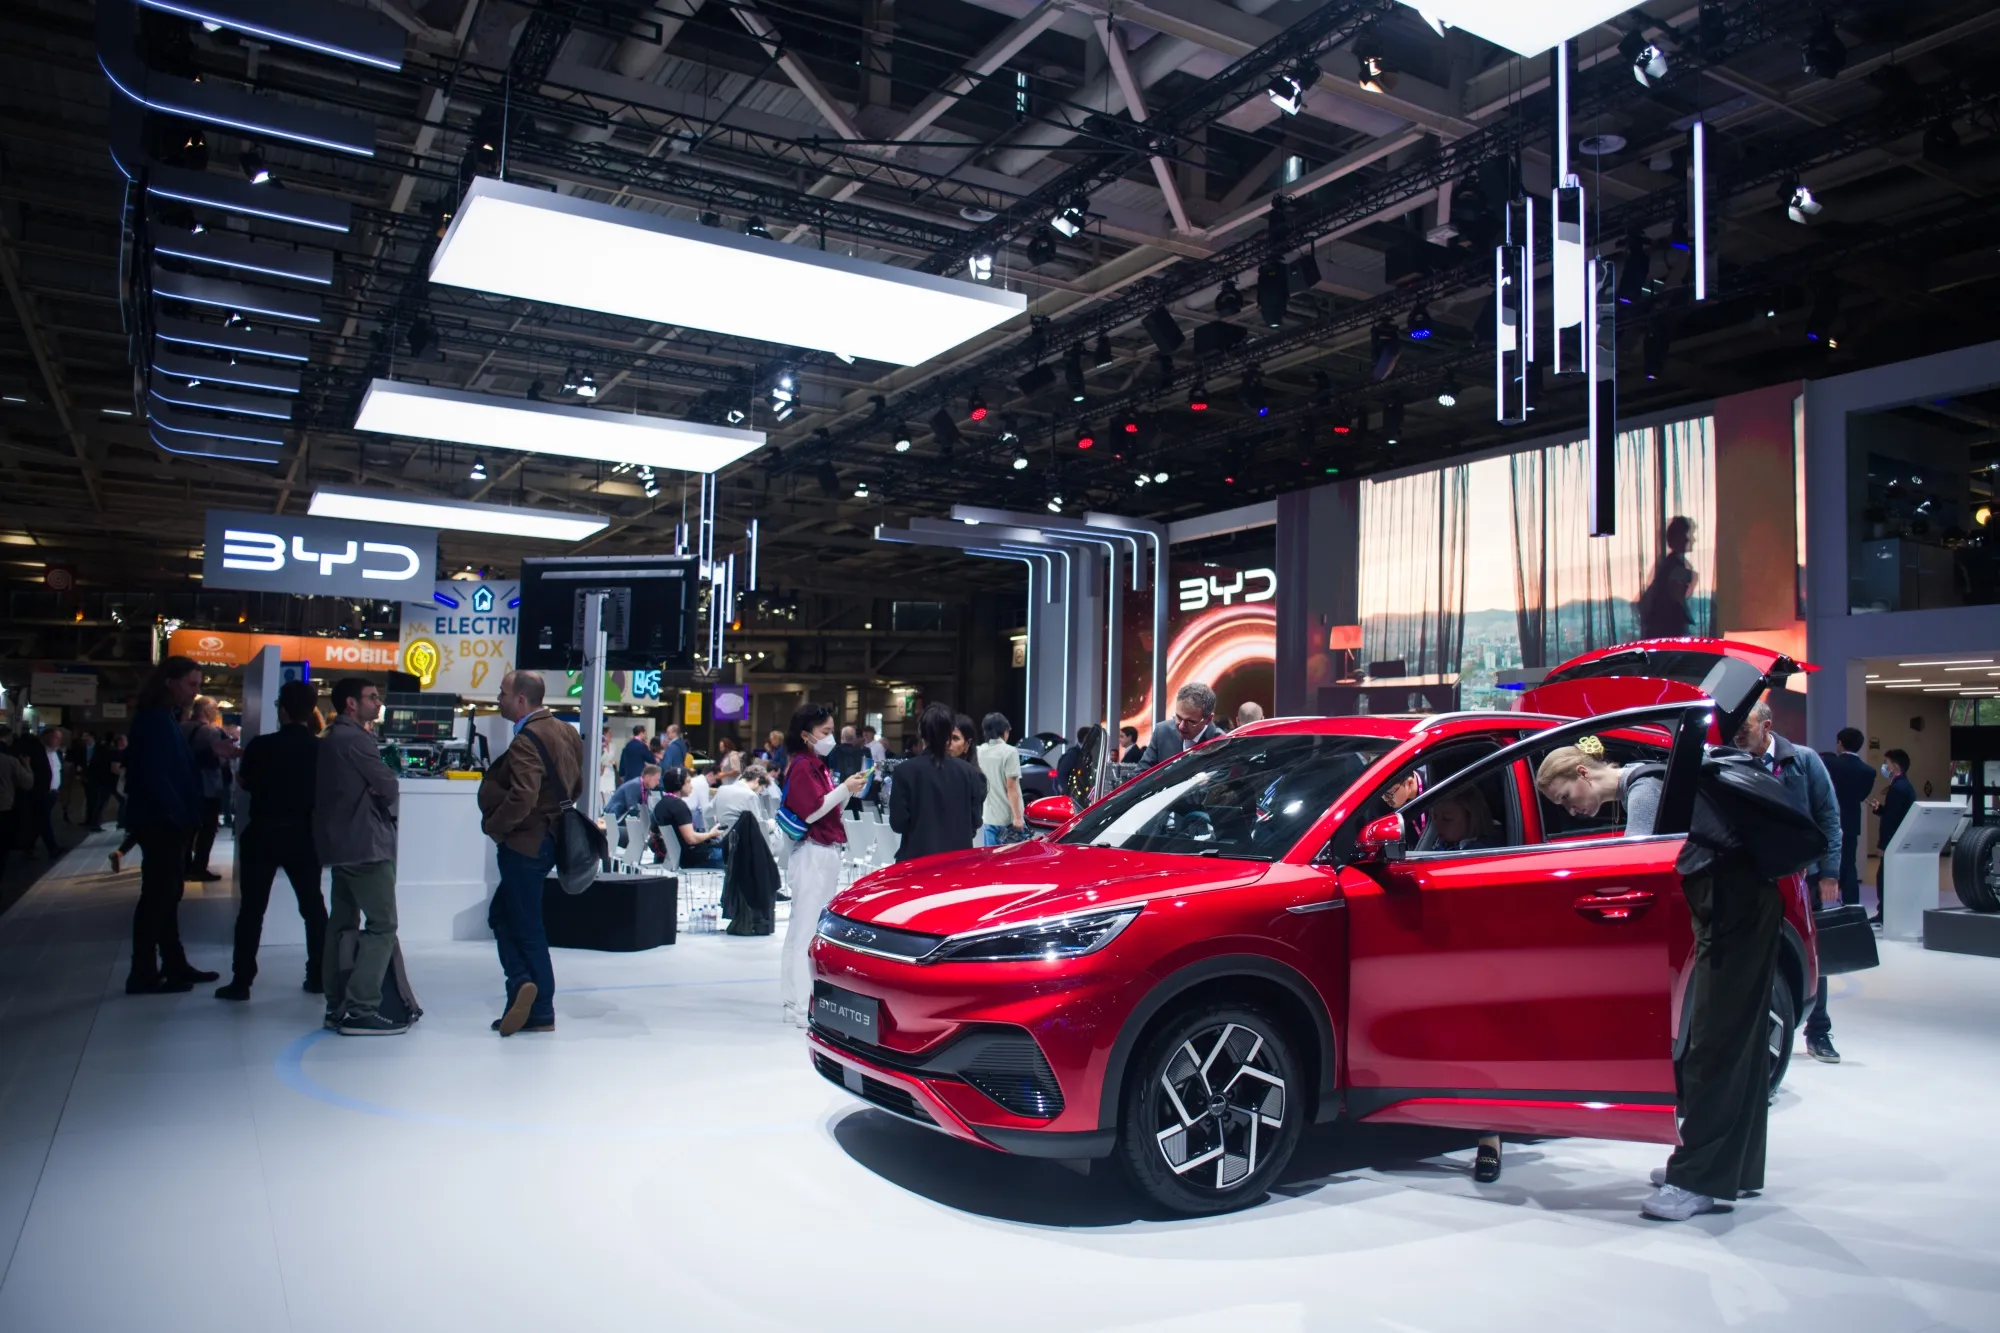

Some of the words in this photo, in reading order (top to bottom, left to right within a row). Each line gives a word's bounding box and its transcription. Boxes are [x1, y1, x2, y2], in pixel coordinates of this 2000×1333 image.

[223, 529, 420, 581] BYD
[1179, 567, 1277, 611] BYD
[435, 616, 517, 635] ELECTRI
[325, 645, 399, 665] MOBILI
[459, 639, 504, 658] BOX
[818, 998, 837, 1014] BYD
[838, 1005, 863, 1023] ATTO
[863, 1014, 871, 1026] 3
